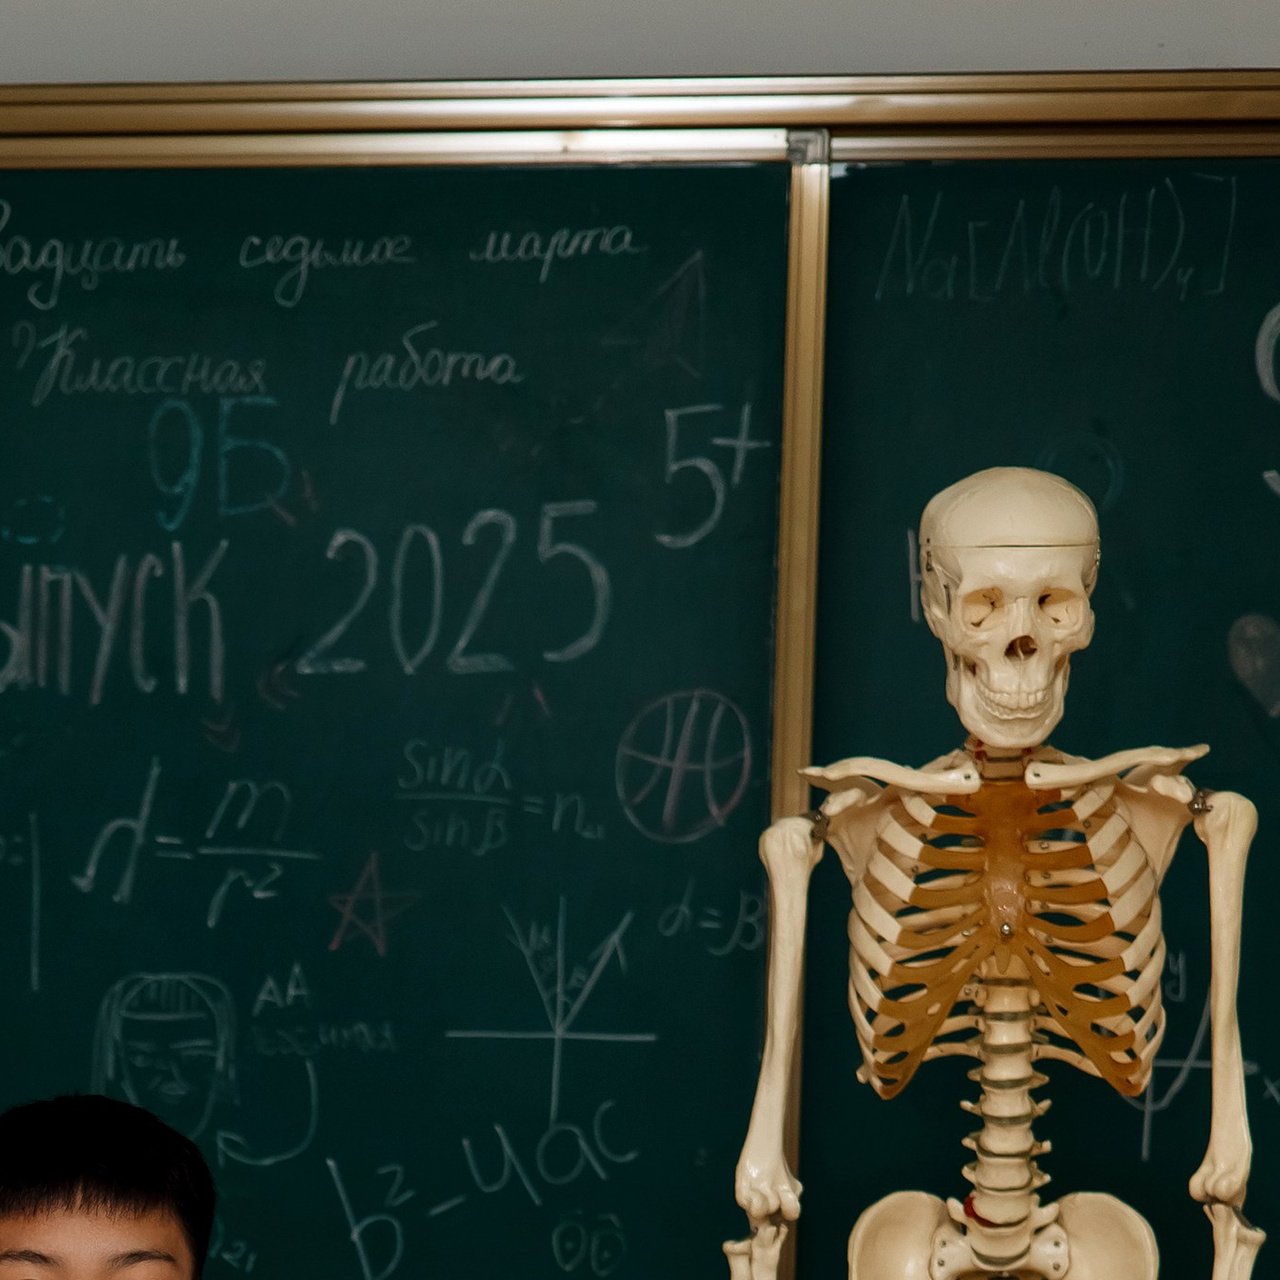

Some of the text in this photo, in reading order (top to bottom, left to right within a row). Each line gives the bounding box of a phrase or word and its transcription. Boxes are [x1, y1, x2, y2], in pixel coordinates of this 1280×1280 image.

[238, 231, 419, 308] седьмое
[468, 224, 650, 284] марта
[30, 320, 528, 426] Классная работа
[653, 385, 772, 550] 5+
[294, 498, 614, 676] 2025
